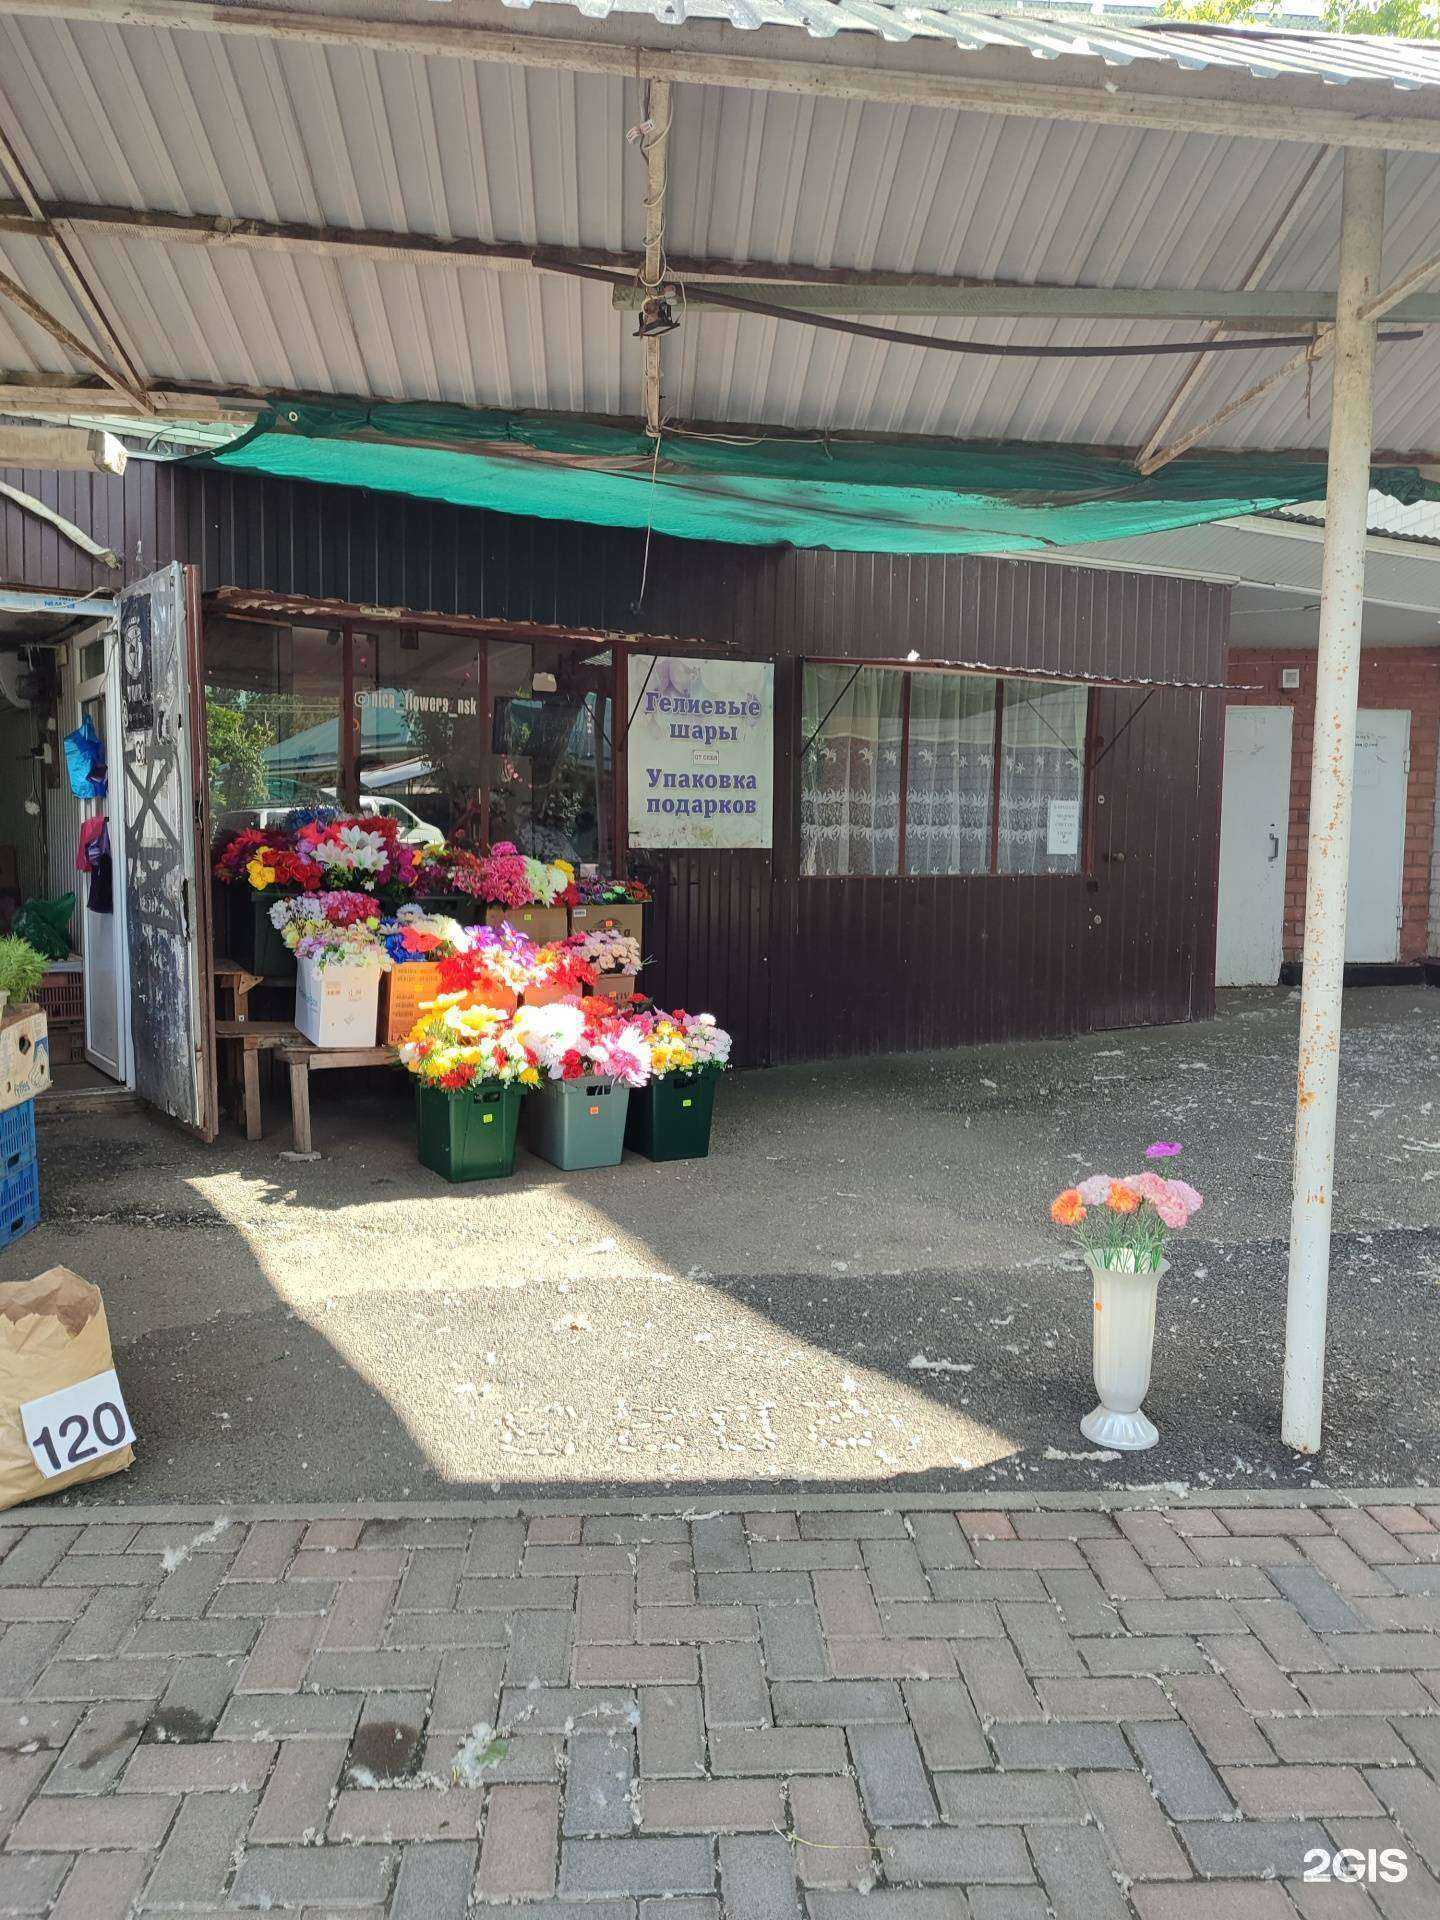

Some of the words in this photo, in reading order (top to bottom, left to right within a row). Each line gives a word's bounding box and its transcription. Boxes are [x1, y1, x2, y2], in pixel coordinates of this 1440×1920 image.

[645, 692, 761, 717] Гелиевые
[670, 723, 738, 745] шары
[646, 768, 757, 790] Упаковка
[646, 797, 757, 818] подарков
[32, 1401, 126, 1471] 120
